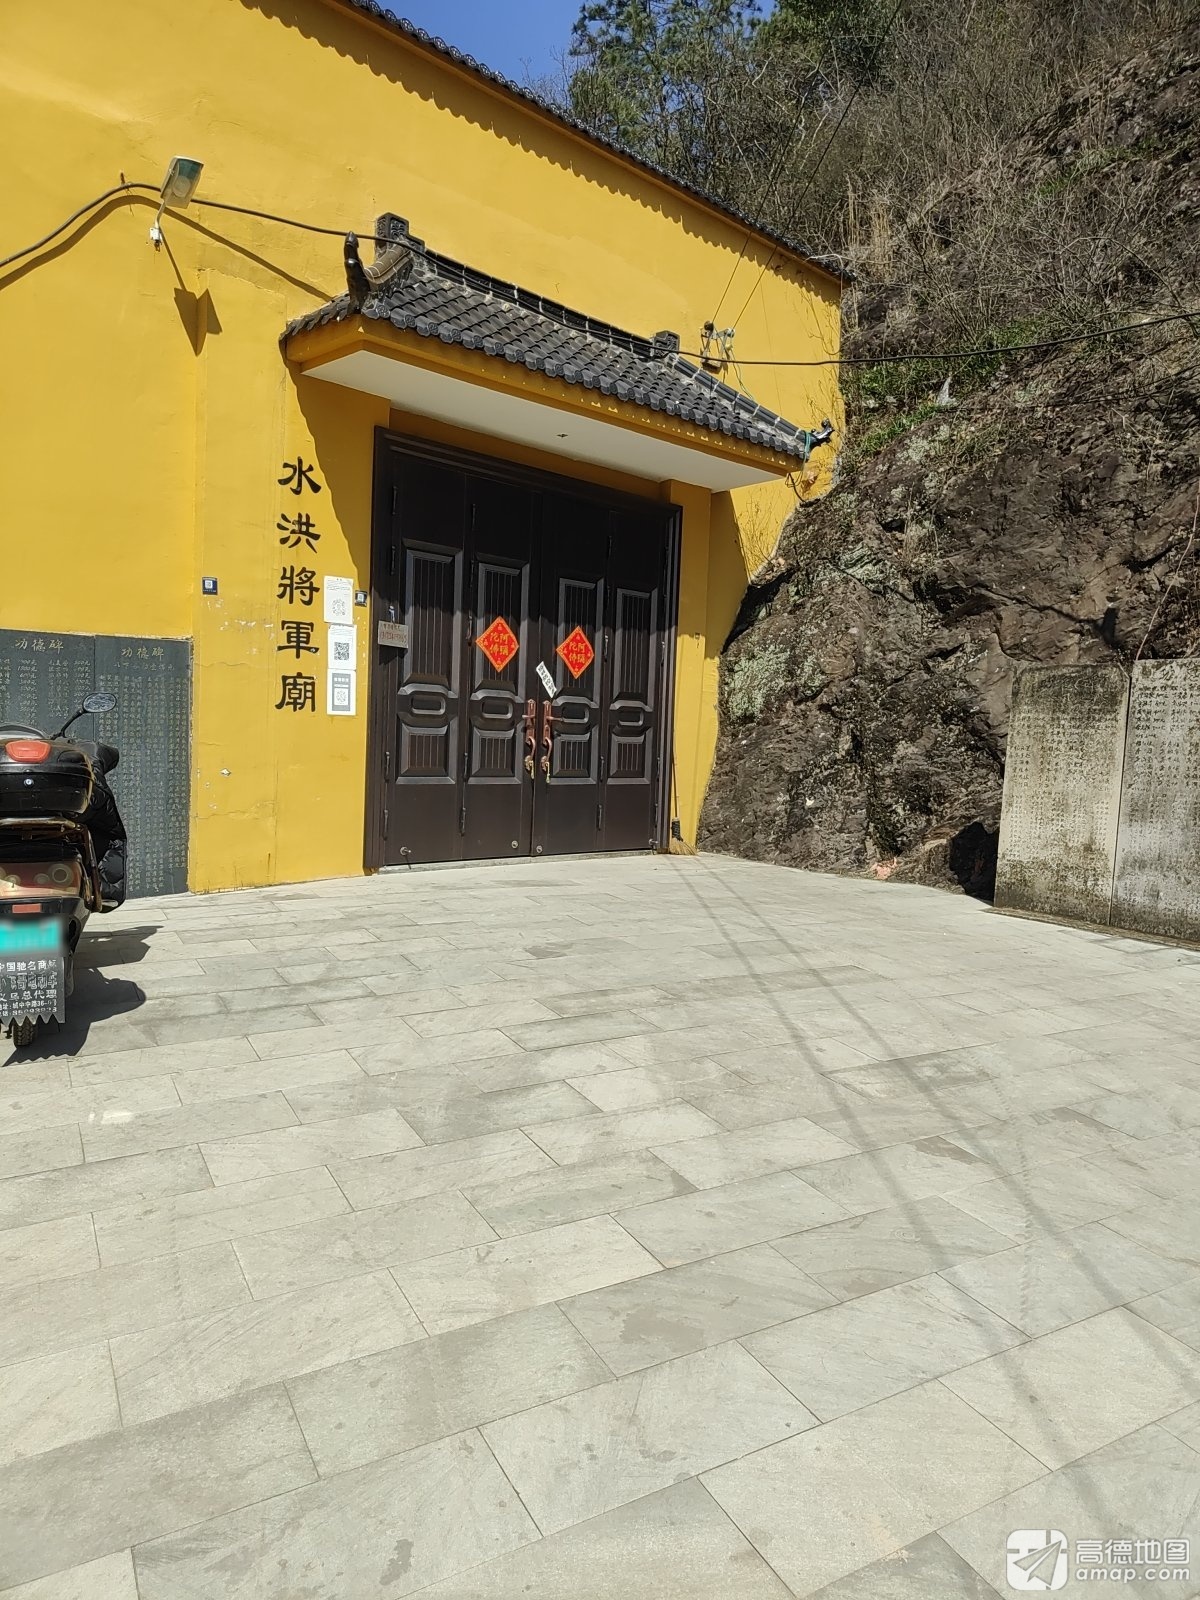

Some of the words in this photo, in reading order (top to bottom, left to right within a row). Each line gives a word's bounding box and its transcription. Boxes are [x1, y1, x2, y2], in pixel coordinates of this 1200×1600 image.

[15, 638, 64, 655] 功德碑
[121, 645, 164, 661] 功德碑
